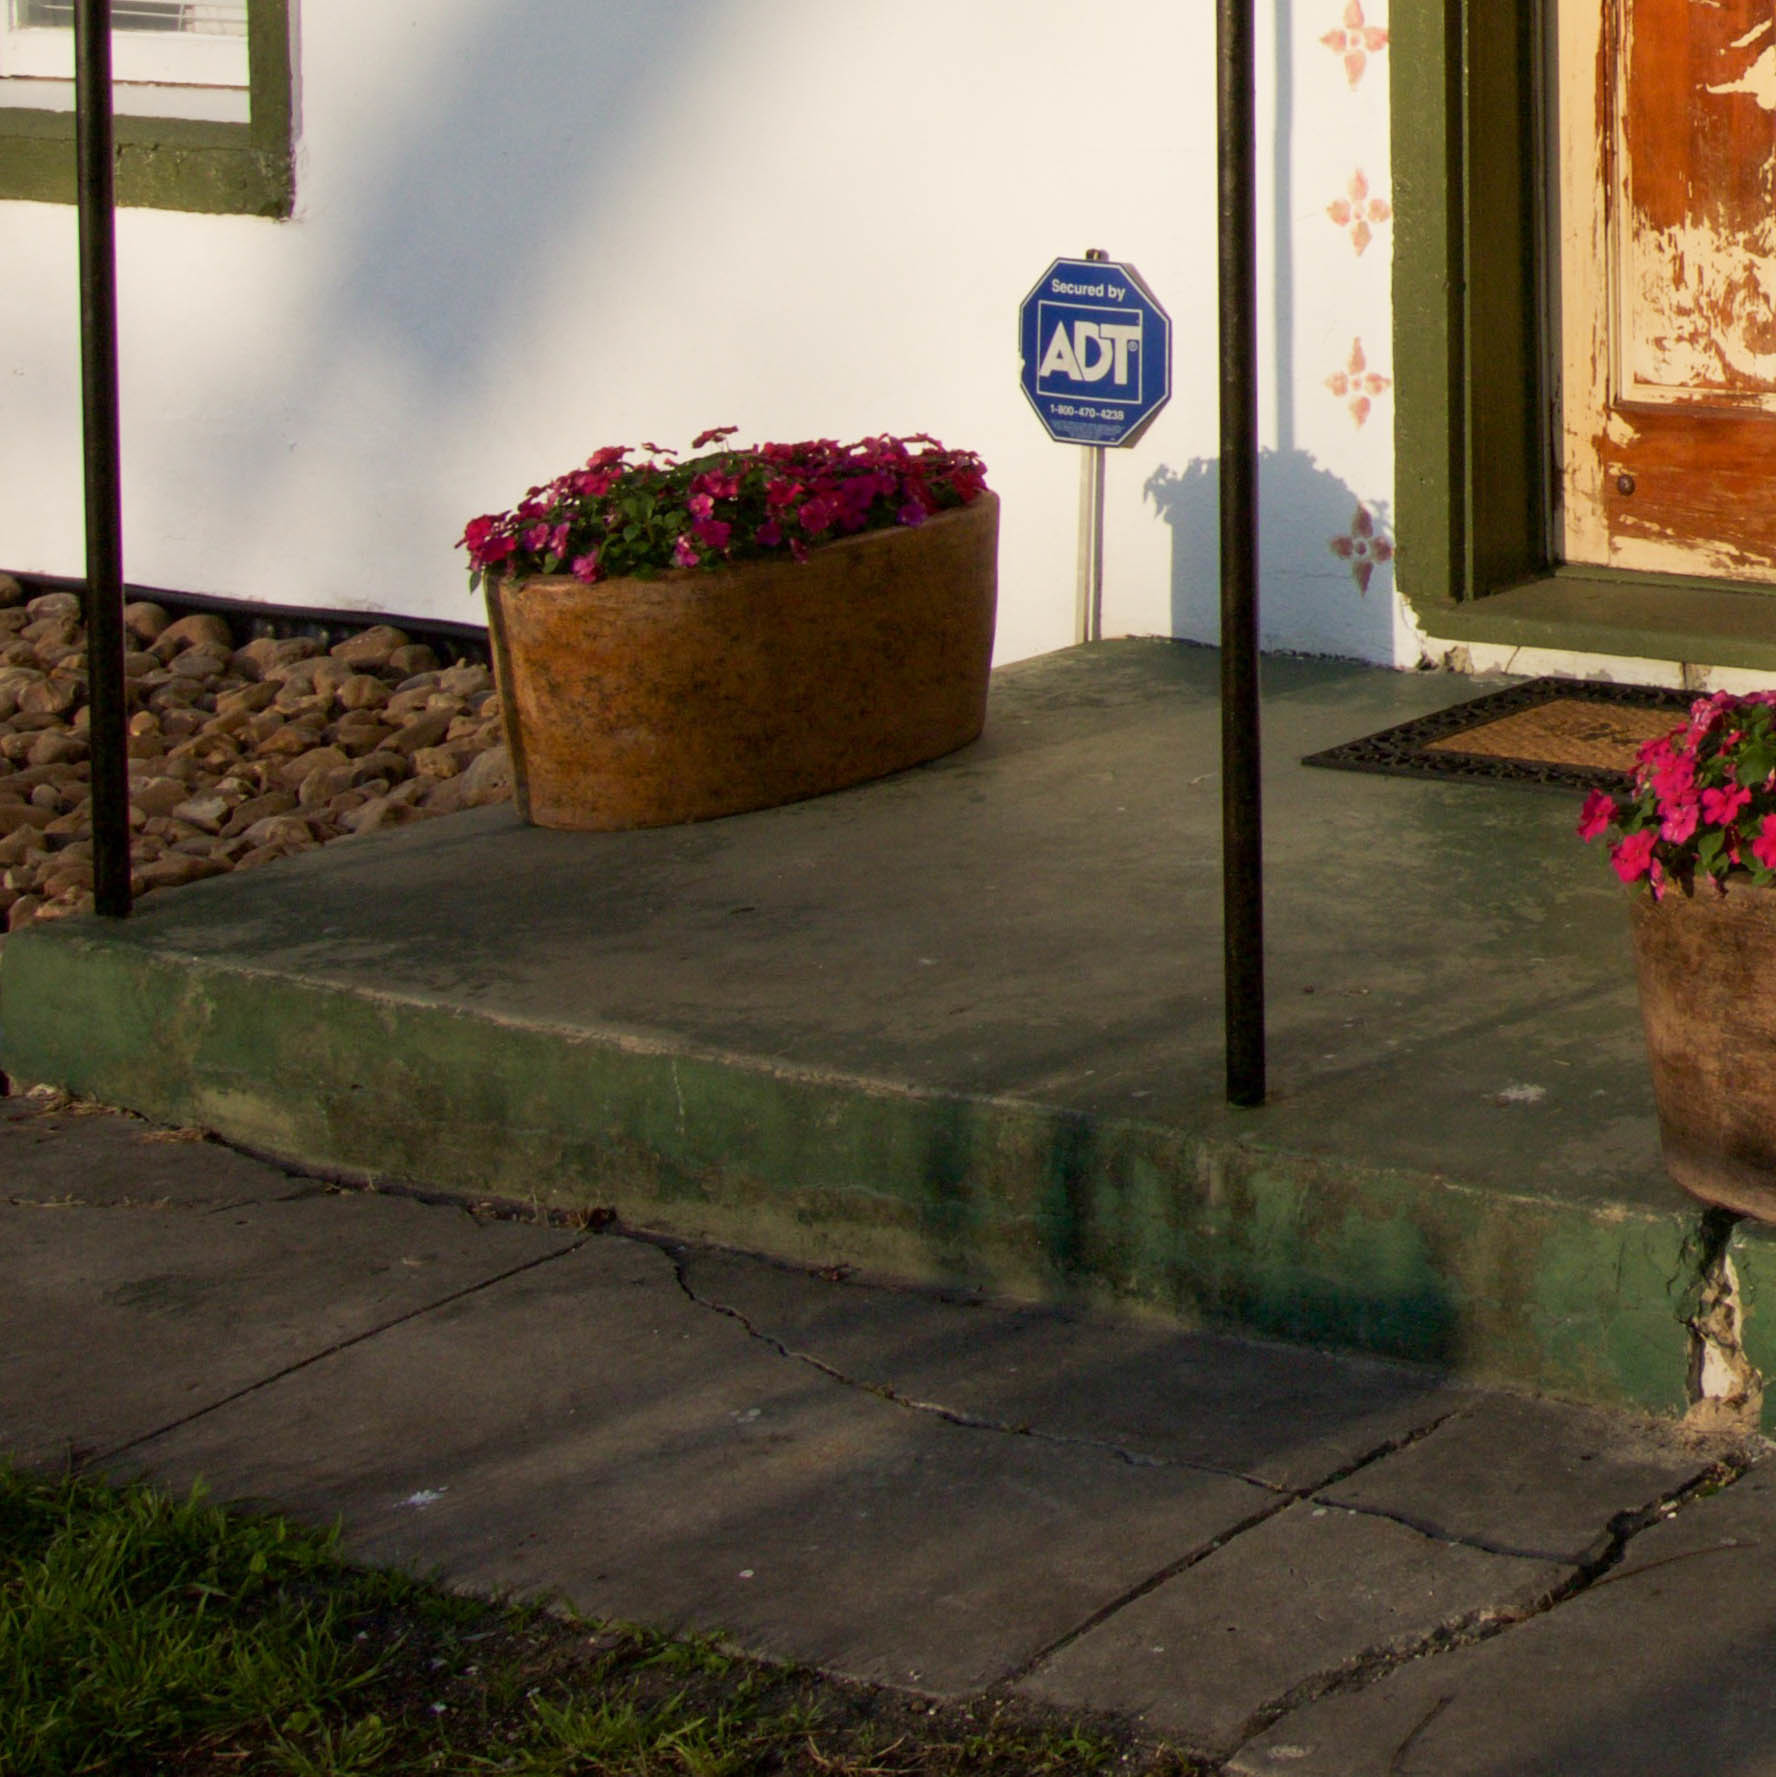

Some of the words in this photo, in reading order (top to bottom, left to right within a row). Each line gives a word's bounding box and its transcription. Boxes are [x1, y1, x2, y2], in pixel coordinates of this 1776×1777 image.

[1051, 278, 1104, 297] Secured
[1108, 284, 1126, 302] by
[1039, 320, 1140, 385] ADT
